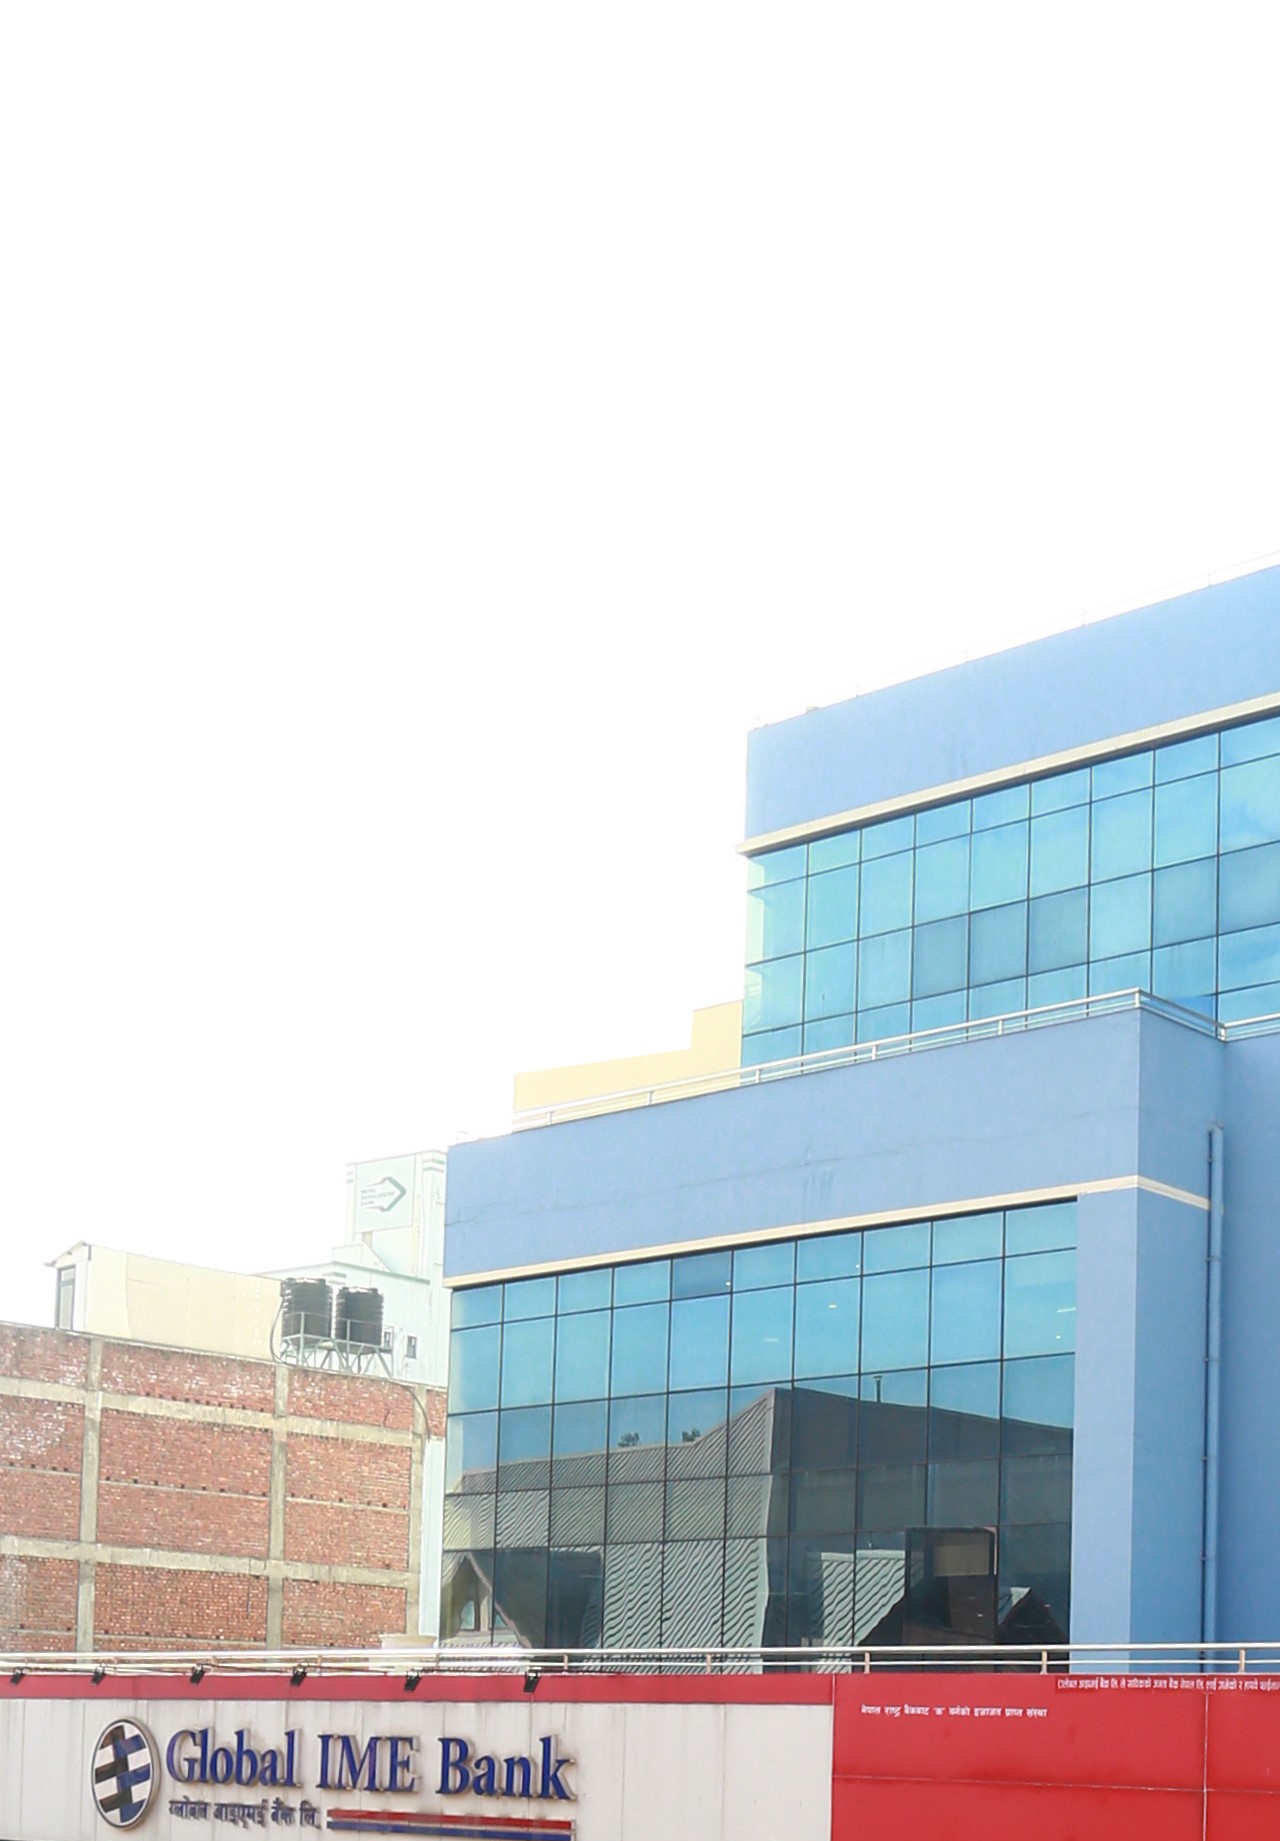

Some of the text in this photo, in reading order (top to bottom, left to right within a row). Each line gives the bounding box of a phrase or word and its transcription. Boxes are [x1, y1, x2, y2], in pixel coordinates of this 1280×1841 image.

[165, 1727, 578, 1800] Global IME Bank
